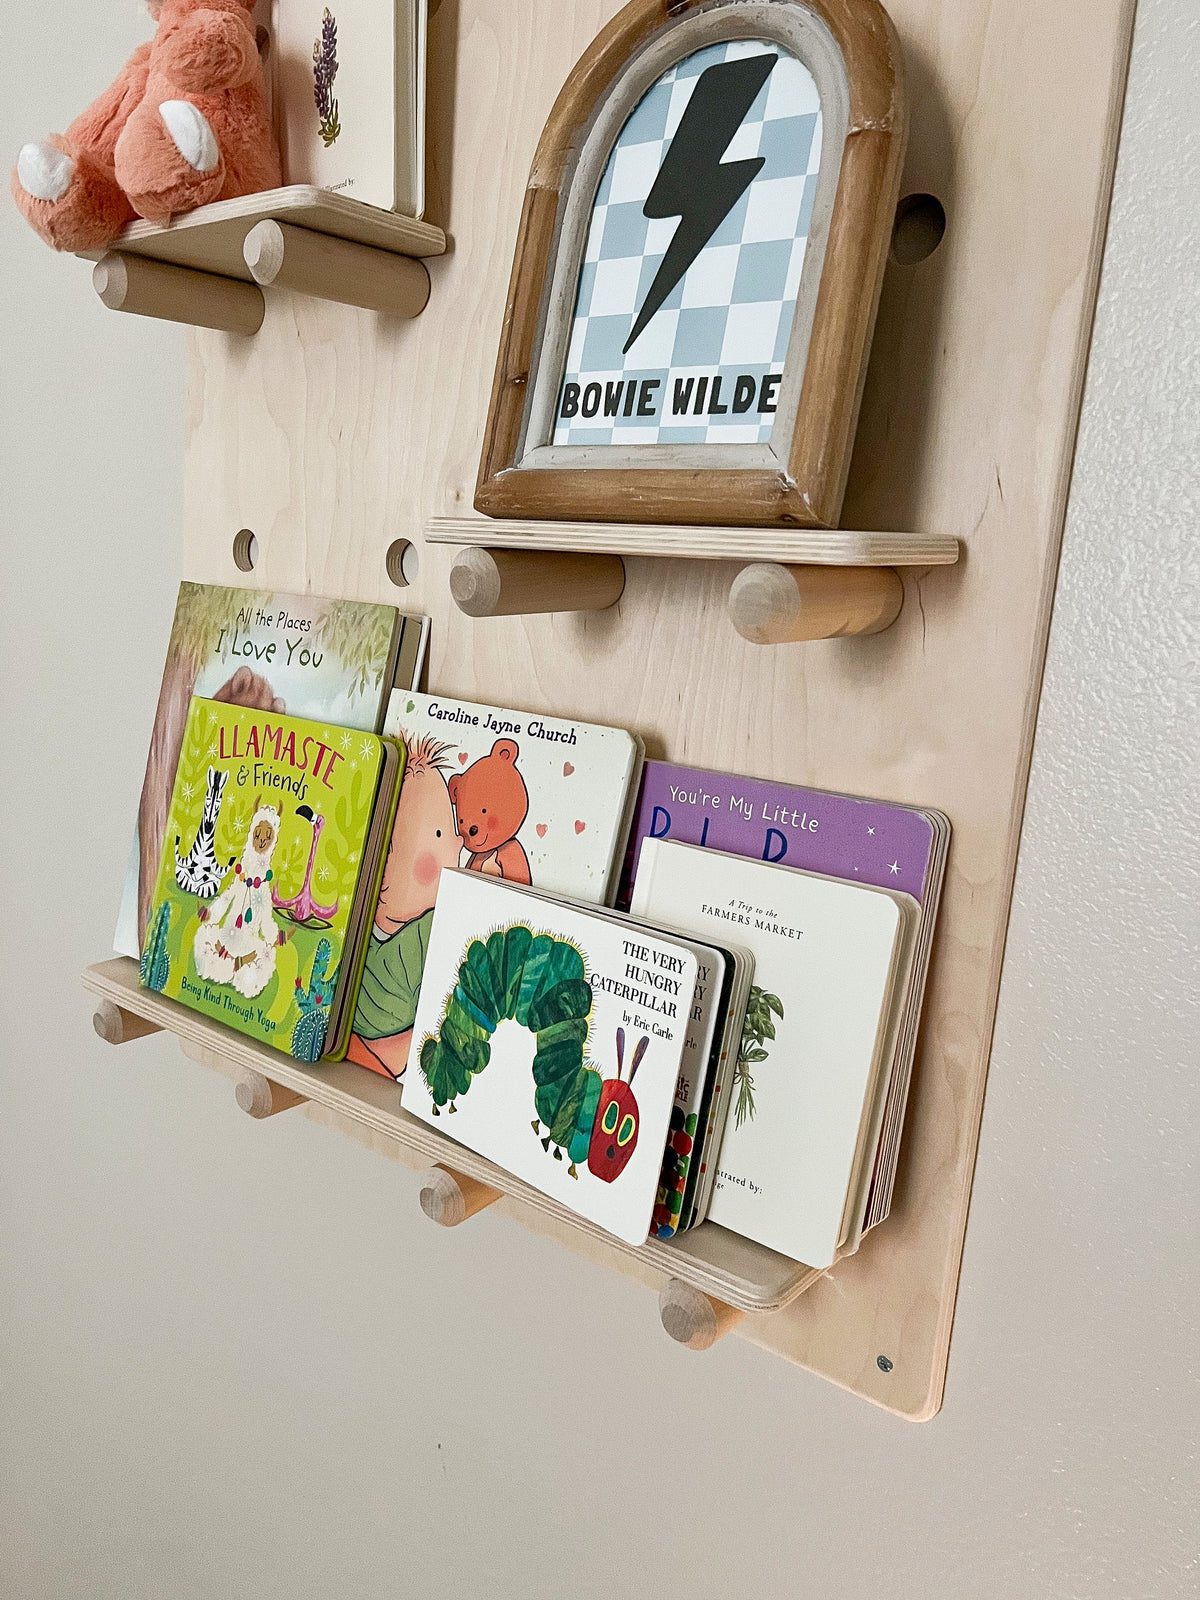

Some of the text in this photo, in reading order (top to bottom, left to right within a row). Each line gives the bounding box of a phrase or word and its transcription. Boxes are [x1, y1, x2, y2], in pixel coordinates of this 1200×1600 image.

[560, 374, 783, 418] BOWIE WILDE
[237, 607, 312, 632] All the Places
[214, 624, 323, 668] I Love You
[428, 703, 577, 745] Caroline Jayne Church
[220, 724, 345, 790] LLAMASTE
[237, 763, 308, 801] & Friends
[669, 785, 819, 833] You're My Little
[701, 904, 804, 940] FARMERS MARKET
[728, 899, 778, 919] A Trip to the
[622, 940, 686, 975] THE VERY
[590, 973, 678, 1019] CATERPILLAR
[624, 964, 683, 996] HUNGRY
[181, 976, 276, 1033] Being Kind Through Yoga
[622, 1010, 674, 1041] by Eric Carle
[749, 1180, 763, 1194] by:
